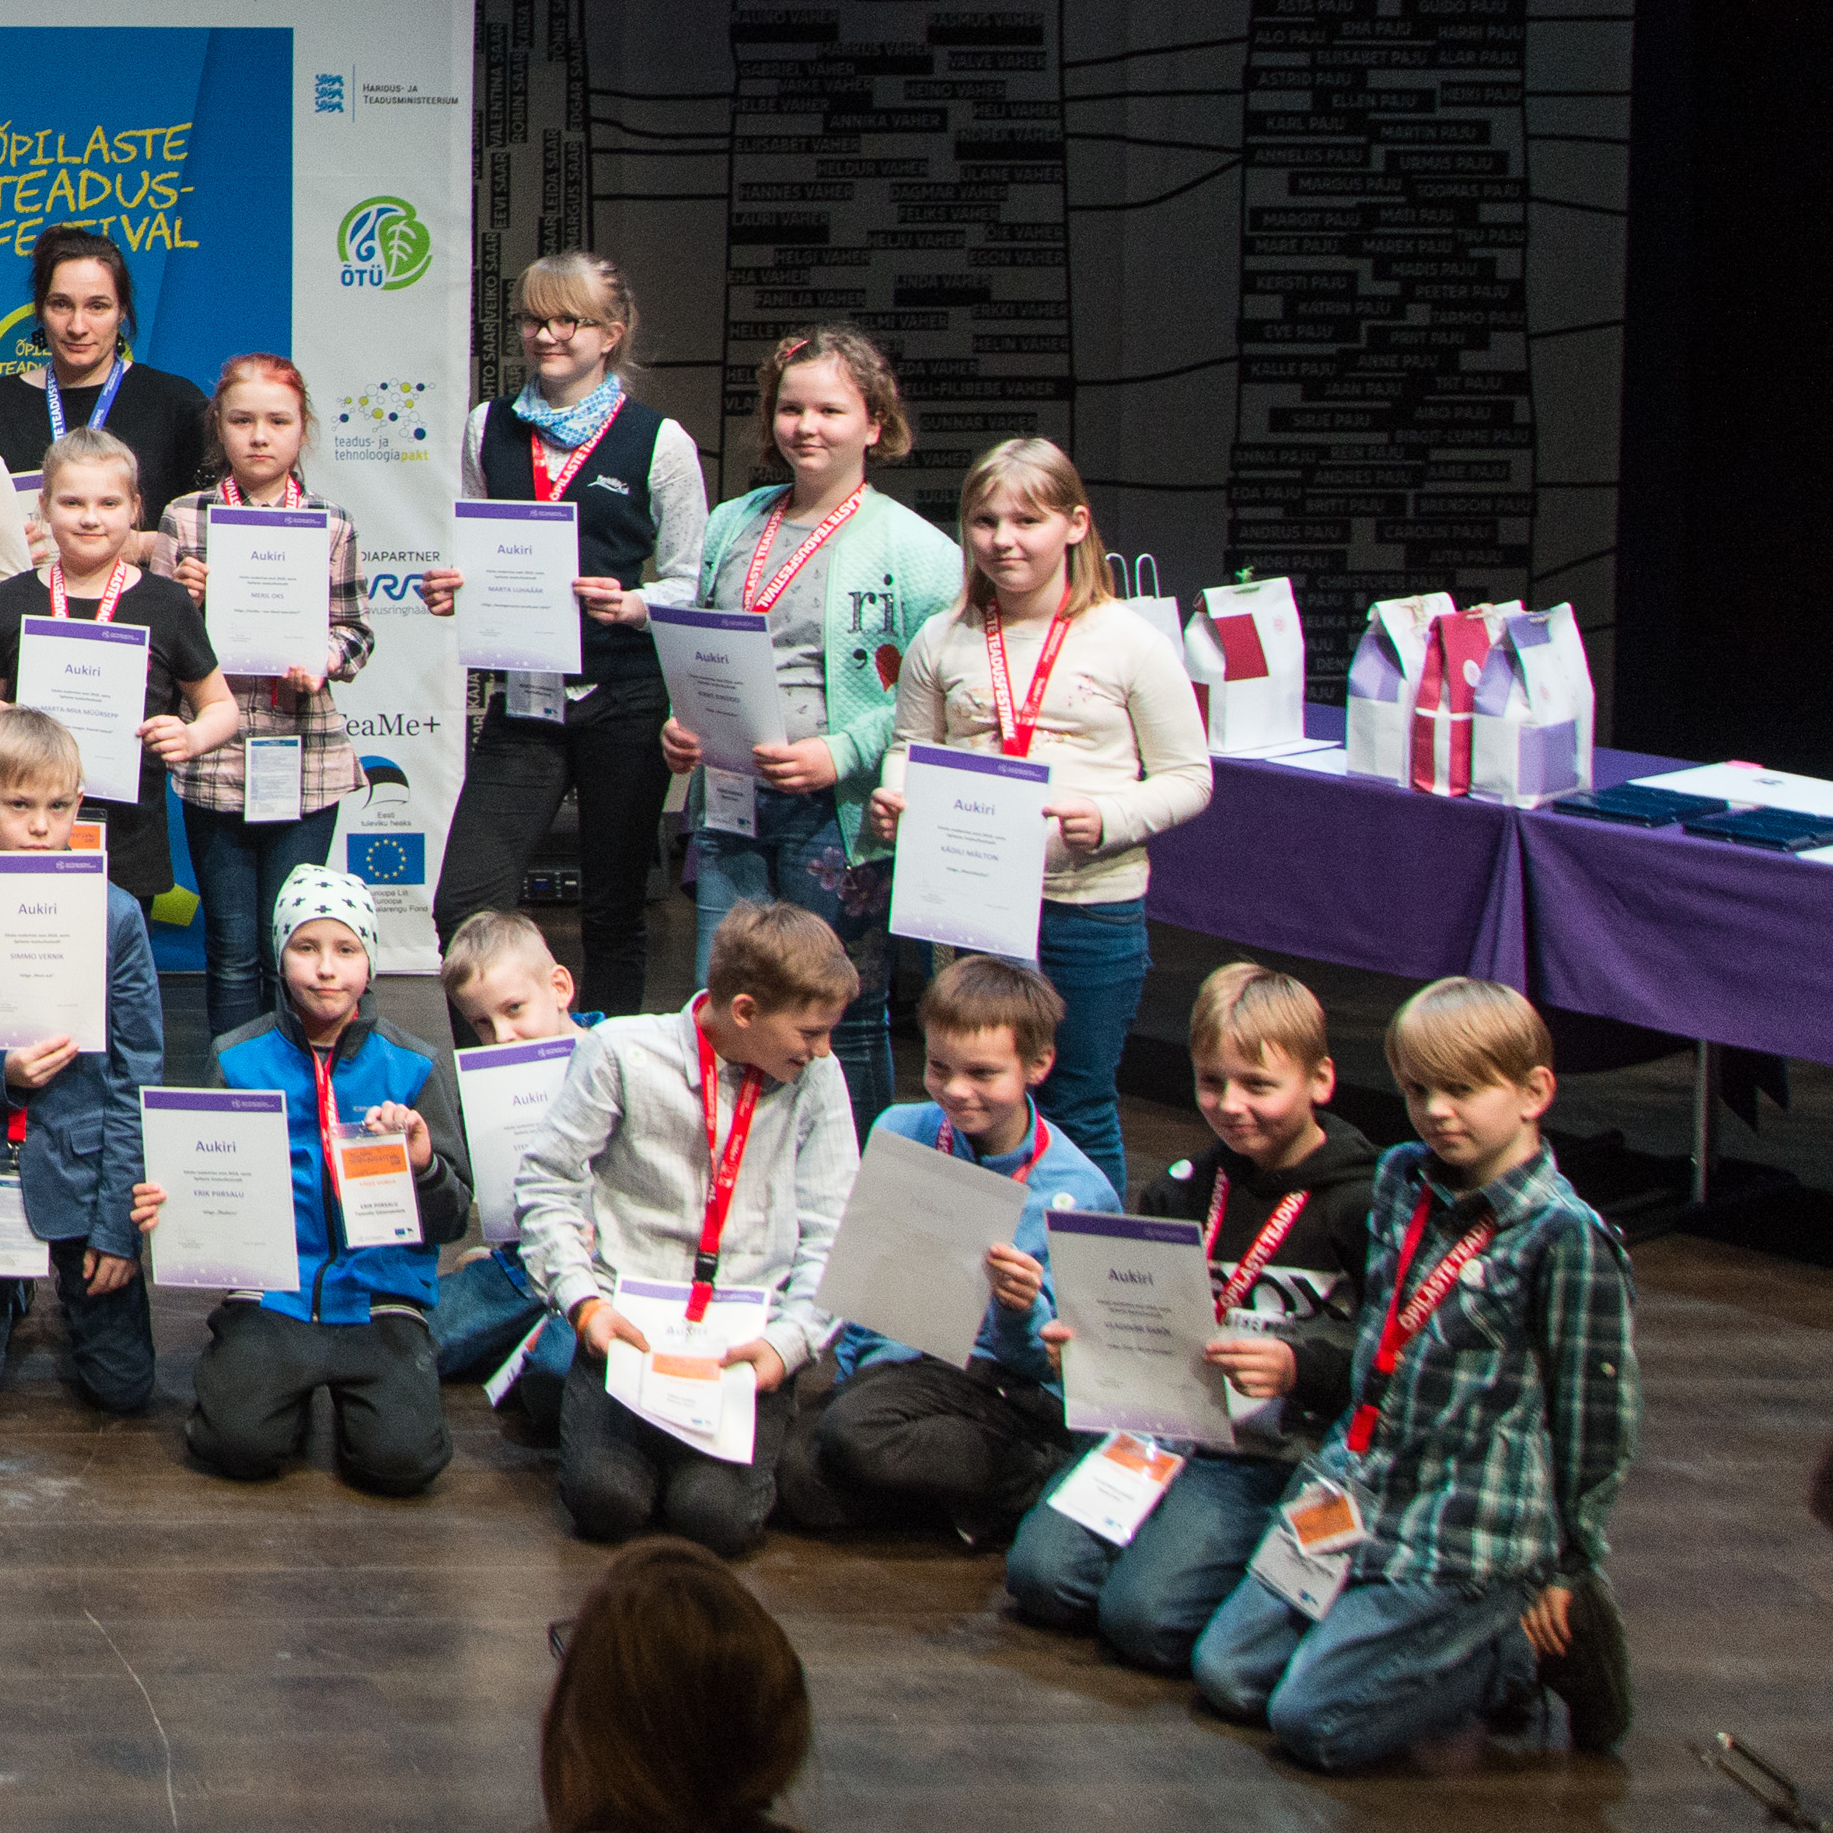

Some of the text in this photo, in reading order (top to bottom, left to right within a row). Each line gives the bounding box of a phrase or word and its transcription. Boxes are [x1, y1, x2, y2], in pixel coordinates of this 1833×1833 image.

[341, 264, 384, 288] ÕTÜ
[335, 436, 390, 450] teadus- ja
[335, 448, 429, 463] tehnoloogiapakt
[549, 449, 586, 501] ÕPILASTE
[251, 551, 285, 561] Aukiri
[497, 545, 532, 554] Aukiri
[758, 520, 833, 609] TEADUSFESTIVAL
[694, 650, 730, 666] Aukiri
[65, 664, 100, 676] Aukiri
[987, 633, 1017, 740] TEADUSFESTIVAL
[339, 713, 441, 736] eaMe+
[954, 799, 994, 815] Aukiri
[18, 904, 57, 914] Aukiri
[514, 1092, 548, 1109] Aukiri
[196, 1141, 236, 1152] Aukiri
[1109, 1269, 1153, 1285] Aukiri
